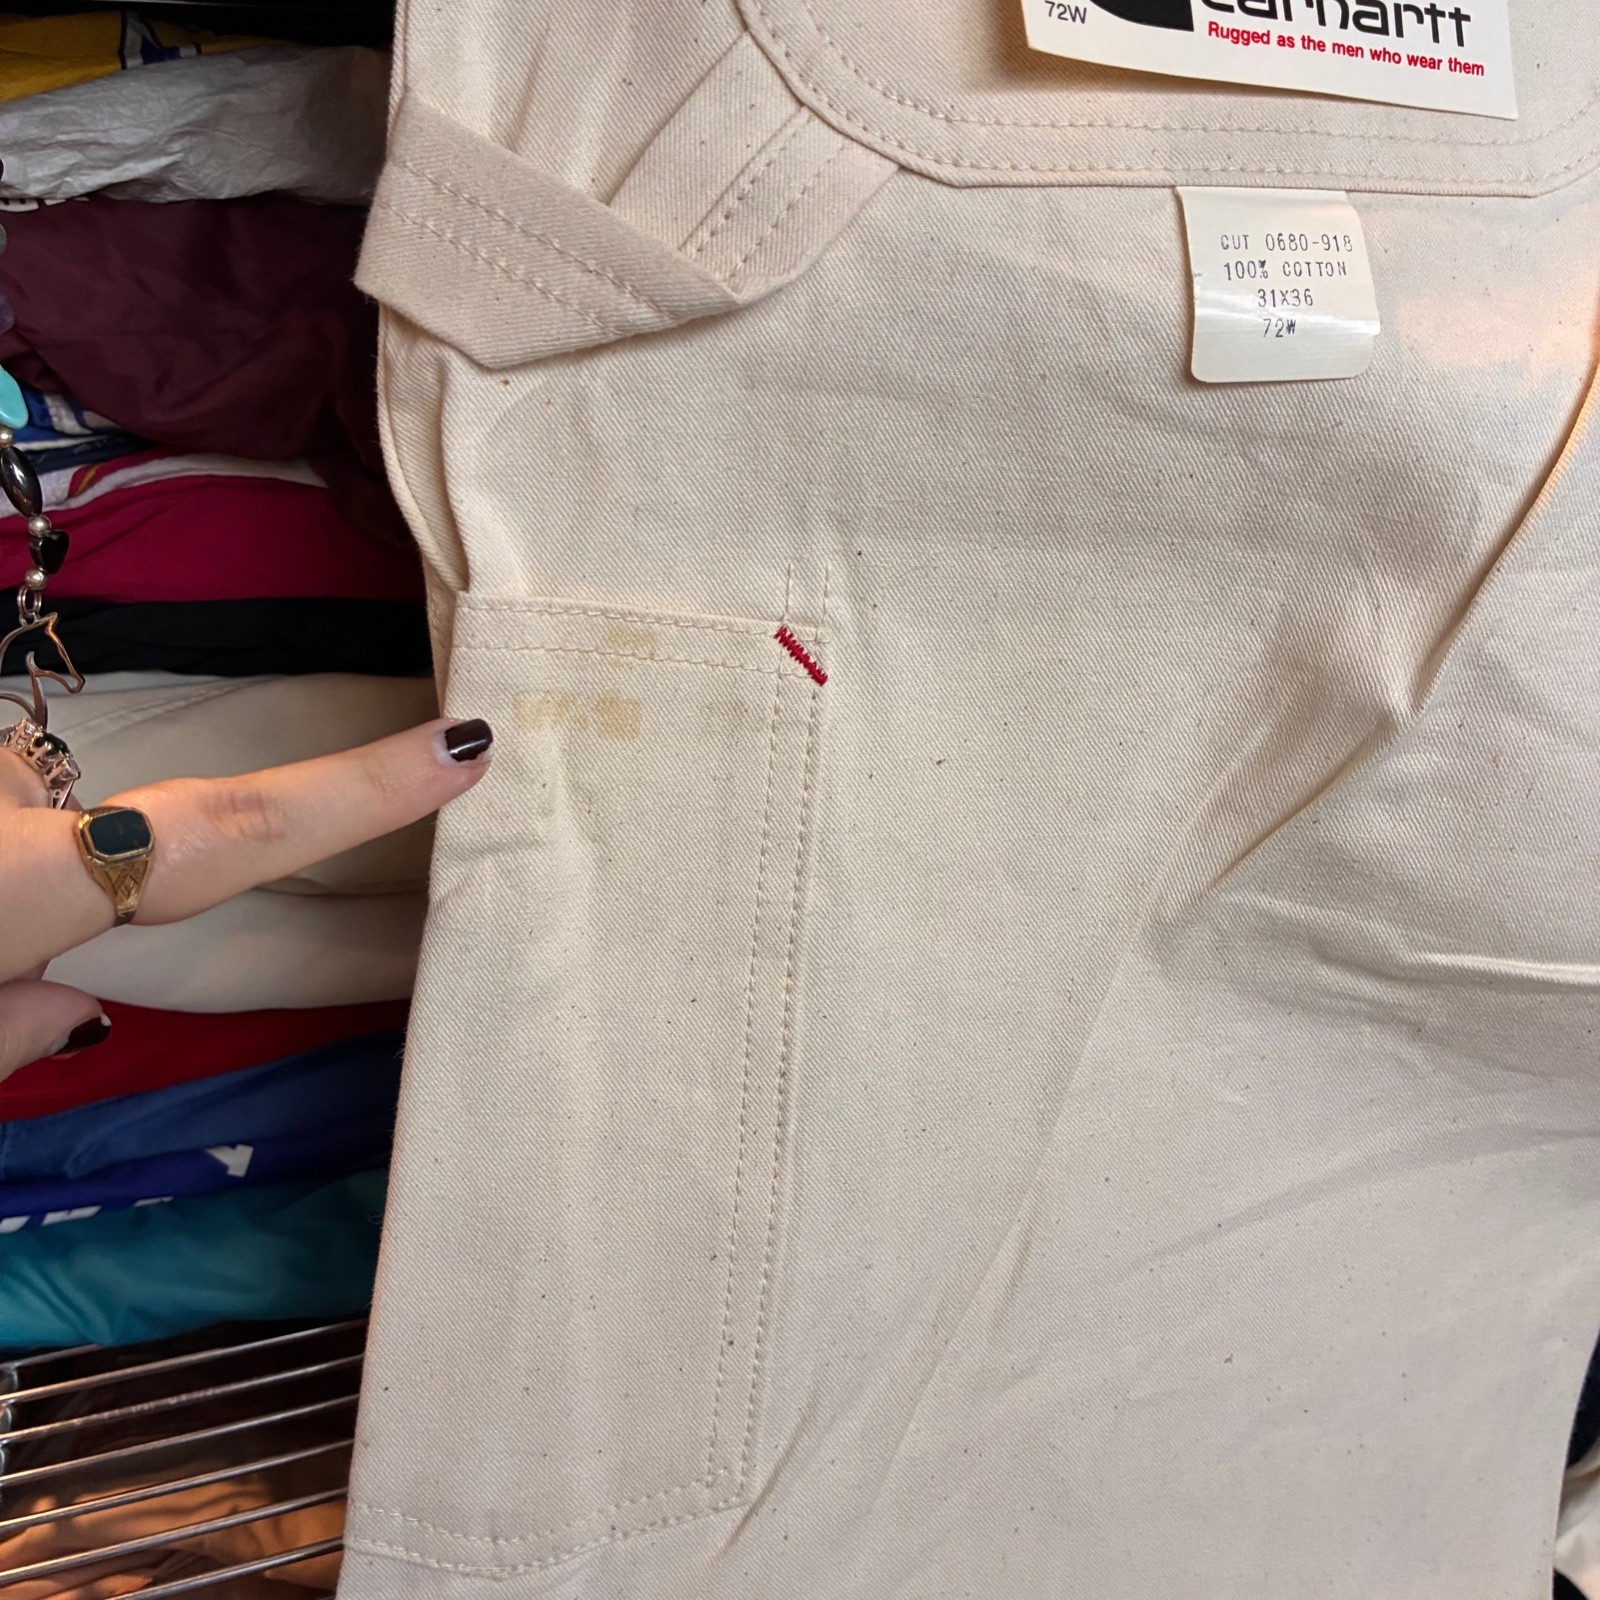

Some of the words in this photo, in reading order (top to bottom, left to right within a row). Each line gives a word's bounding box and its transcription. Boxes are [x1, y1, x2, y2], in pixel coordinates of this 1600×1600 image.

[1044, 0, 1087, 24] 72W
[1208, 20, 1271, 46] Rugged
[1276, 33, 1295, 48] as
[1300, 35, 1326, 51] the
[1332, 43, 1364, 59] men
[1369, 47, 1401, 64] who
[1407, 54, 1443, 70] wear
[1448, 57, 1485, 76] them
[1220, 234, 1249, 250] CUT
[1265, 233, 1353, 252] 0680-918
[1223, 259, 1269, 281] 100%
[1282, 261, 1347, 277] COTTON
[1257, 288, 1314, 308] 31X36
[1262, 318, 1297, 338] 72W
